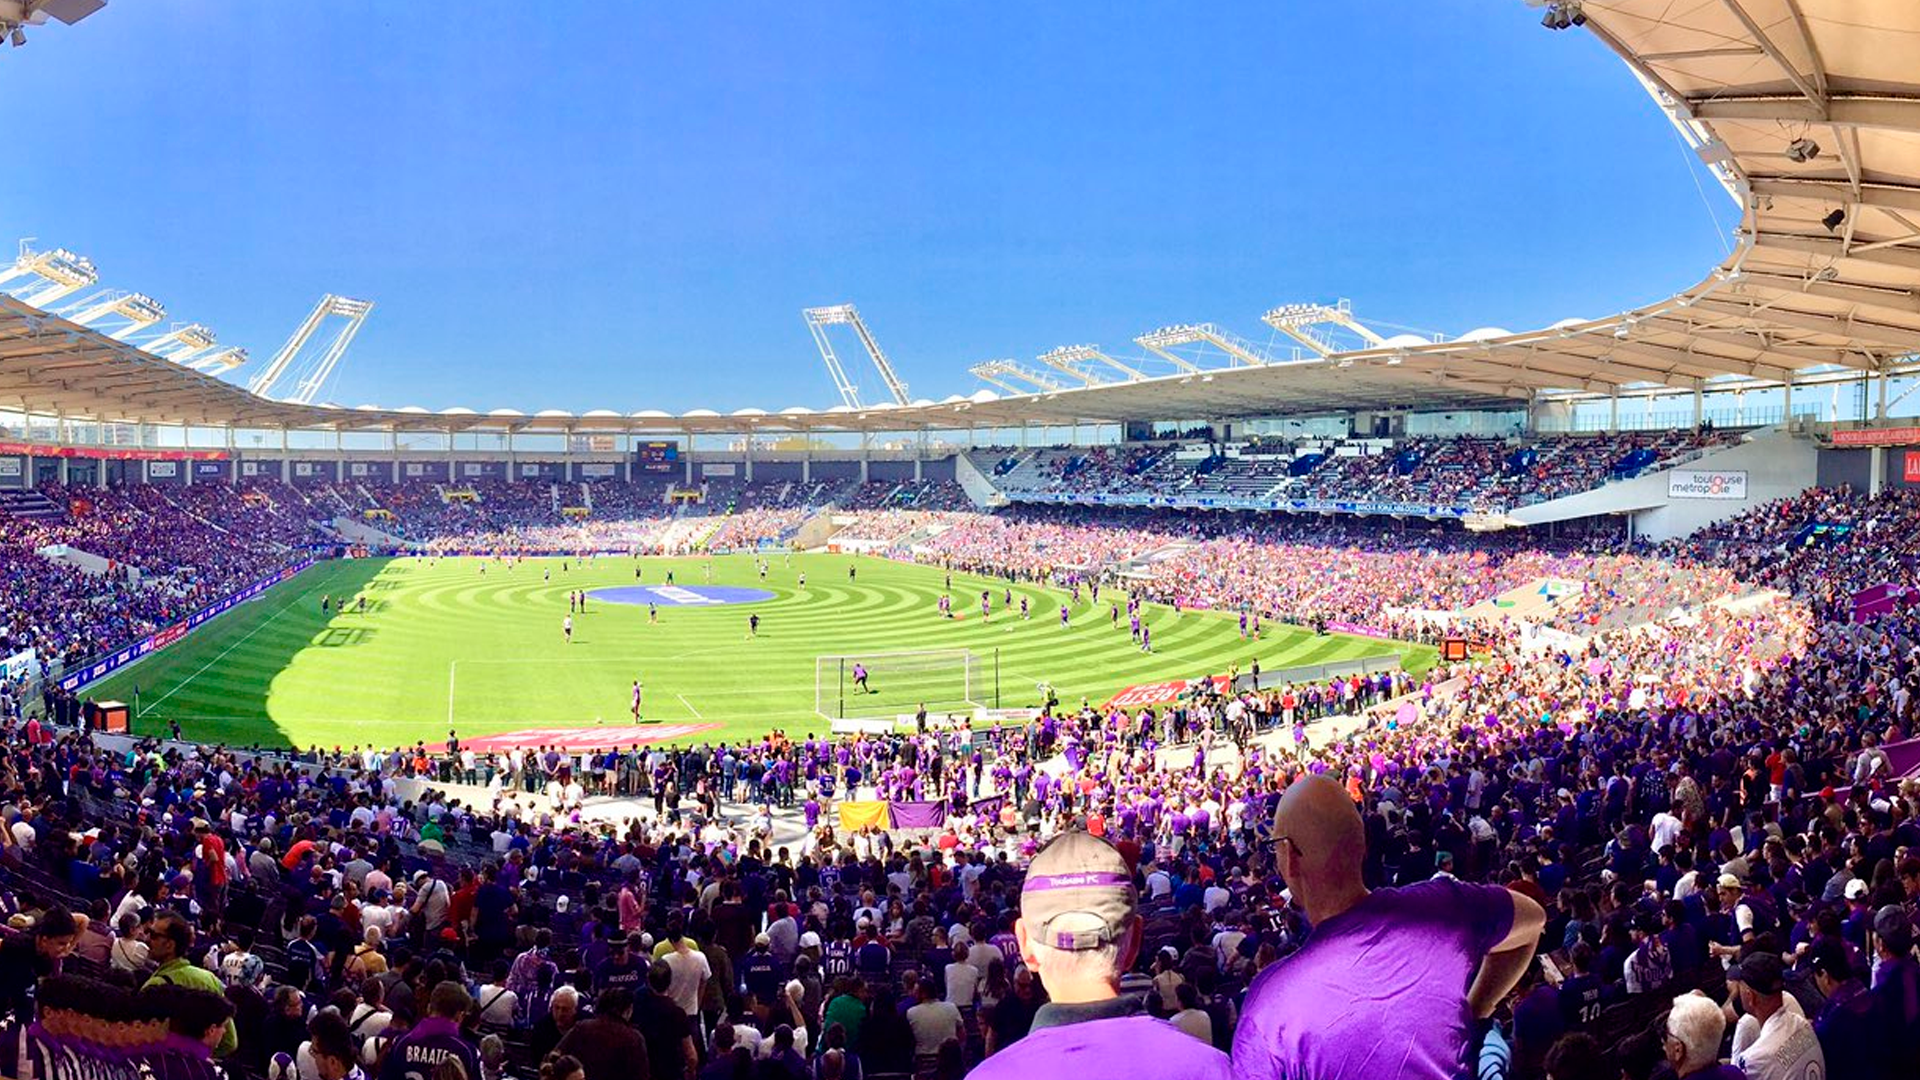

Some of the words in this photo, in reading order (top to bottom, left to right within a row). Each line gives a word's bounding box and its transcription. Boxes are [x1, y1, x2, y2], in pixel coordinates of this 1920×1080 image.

[1693, 475, 1743, 485] toulouse
[1672, 484, 1730, 494] métropole
[829, 958, 846, 974] 10
[406, 1045, 450, 1065] BRAATE
